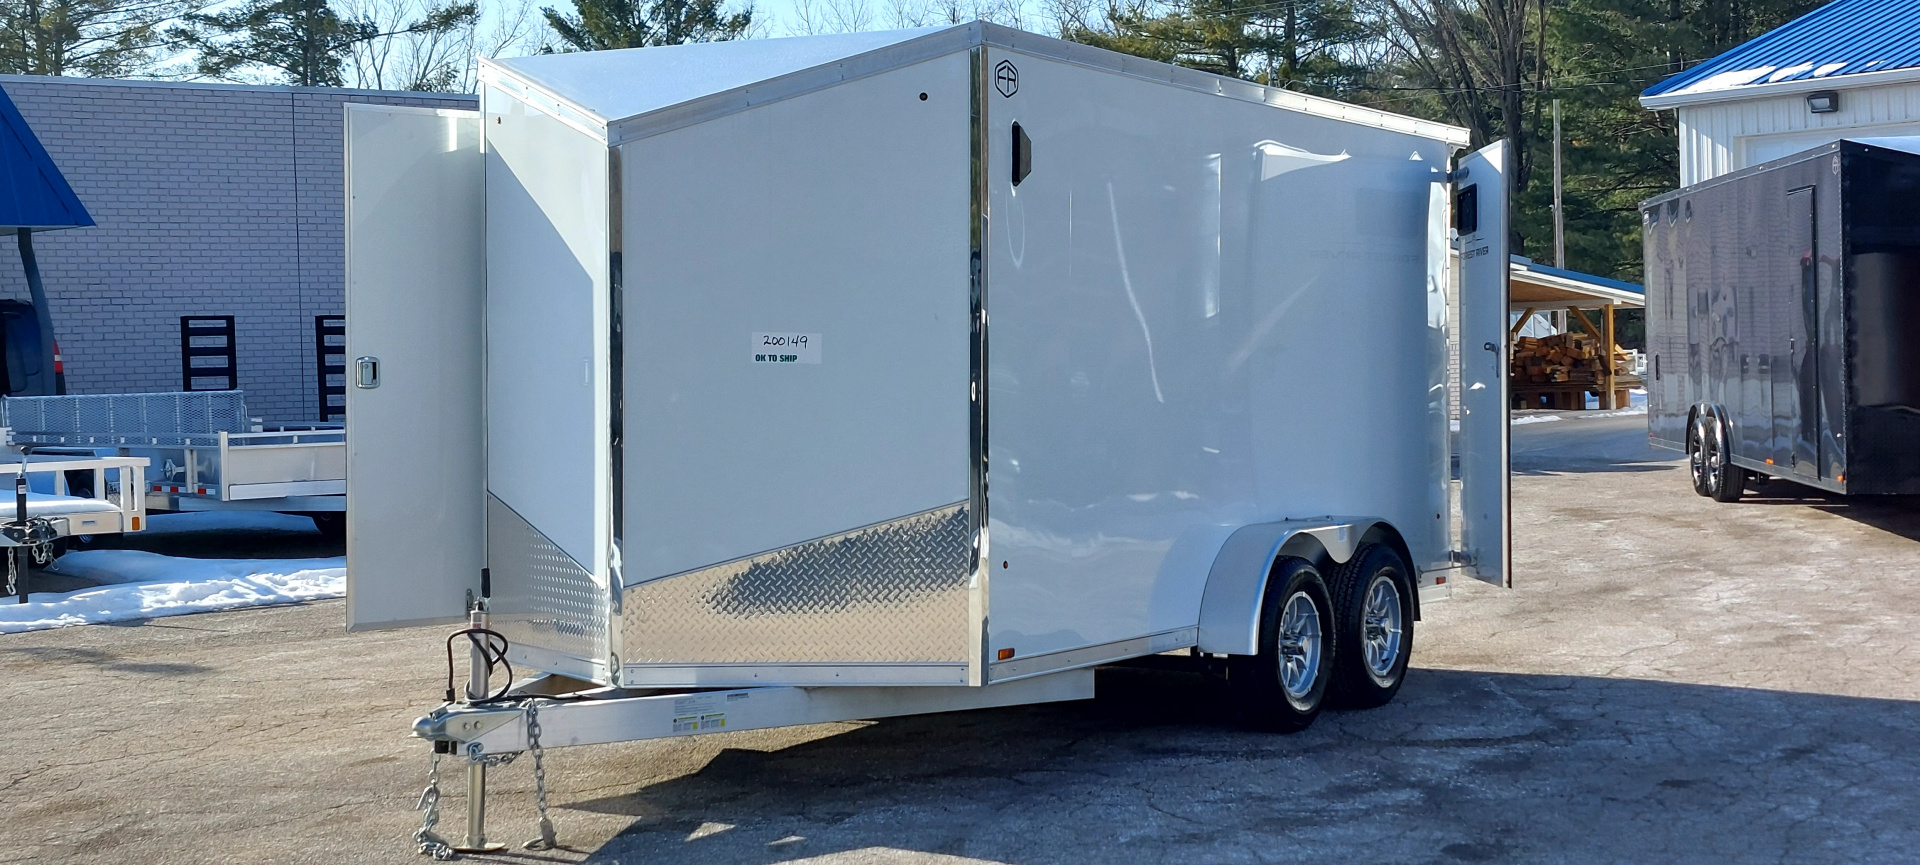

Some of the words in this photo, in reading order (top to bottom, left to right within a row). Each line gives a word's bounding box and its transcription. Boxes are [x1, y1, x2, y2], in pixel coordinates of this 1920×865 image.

[1476, 246, 1489, 257] RIVER
[763, 335, 808, 350] 200149
[755, 354, 766, 362] OK
[768, 354, 777, 363] TO
[780, 354, 798, 363] SHIP
